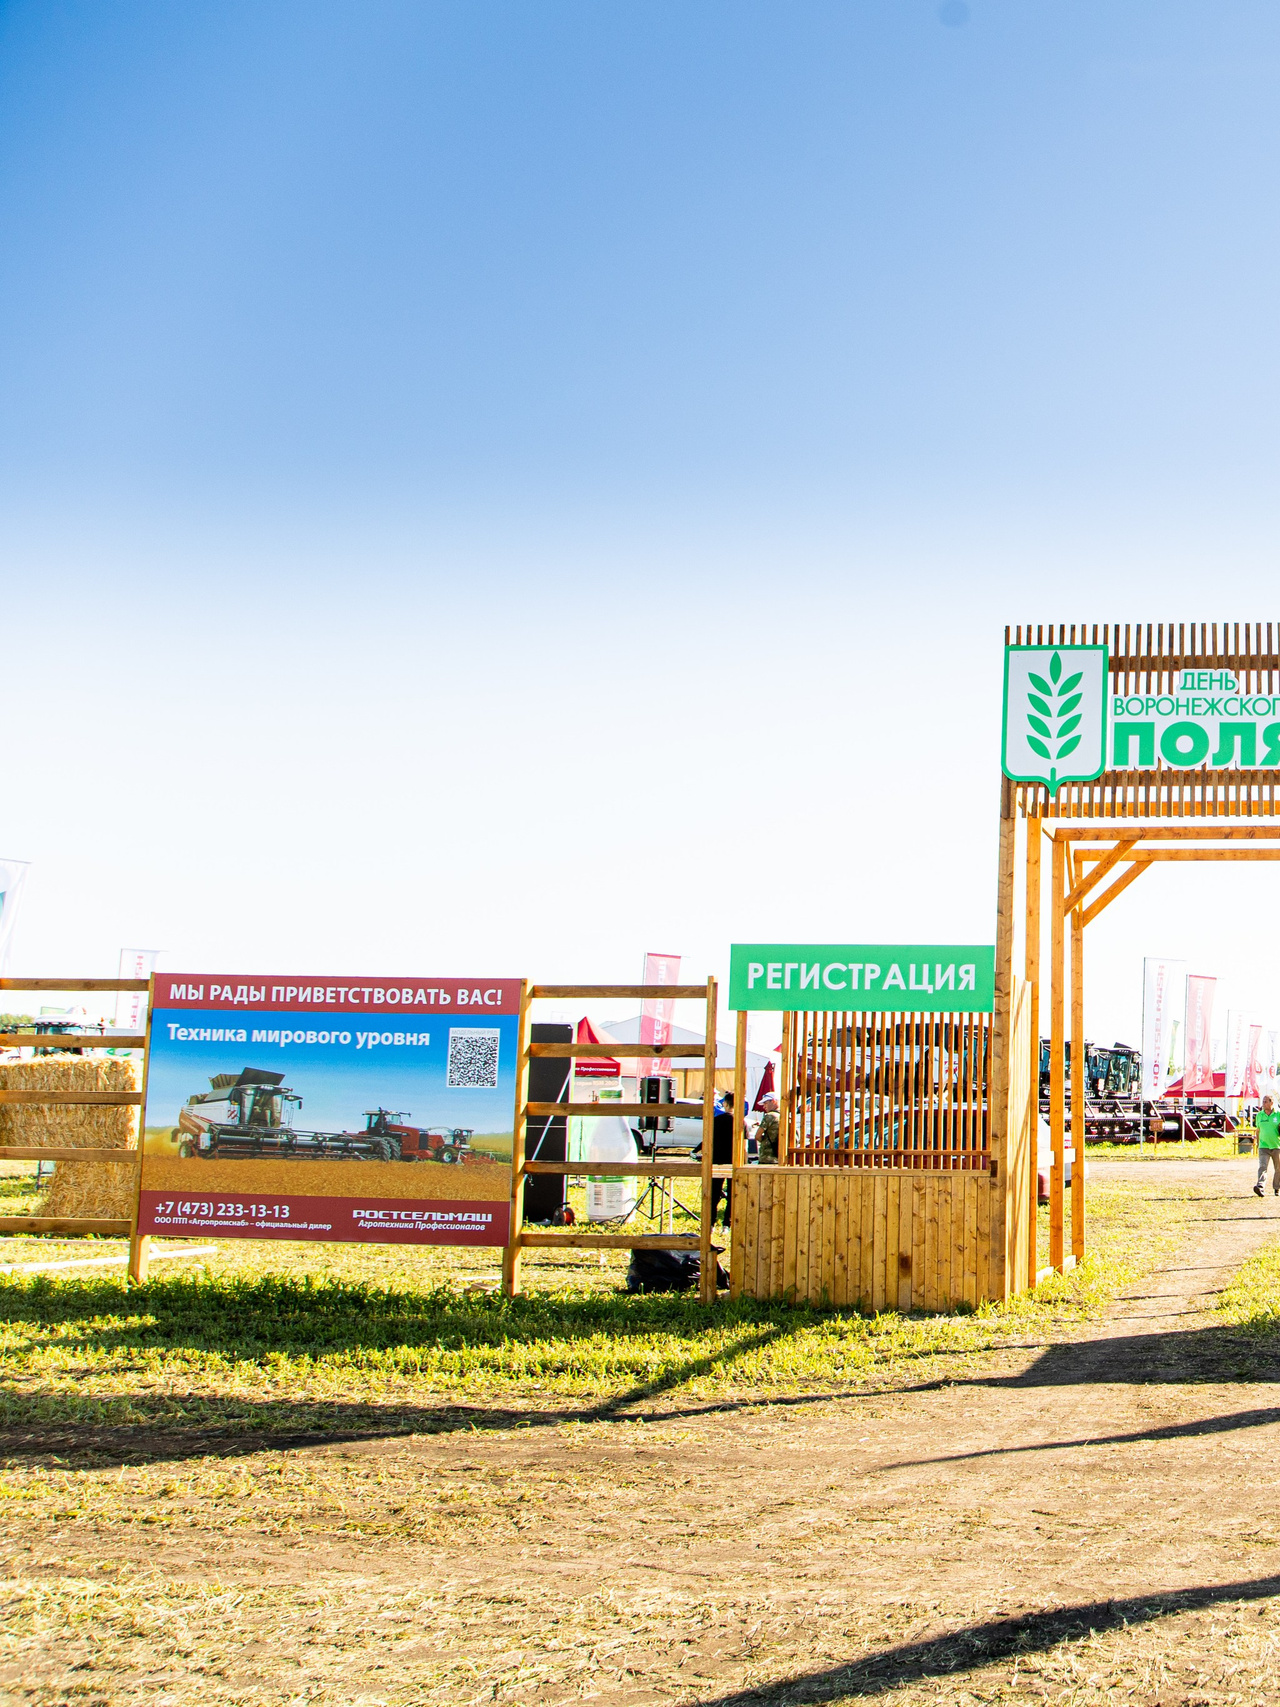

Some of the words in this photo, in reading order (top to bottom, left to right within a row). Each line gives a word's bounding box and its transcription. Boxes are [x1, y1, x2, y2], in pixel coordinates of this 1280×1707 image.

[1180, 672, 1236, 690] ДЕНЬ
[747, 962, 976, 994] РЕГИСТРАЦИЯ
[169, 983, 205, 1000] МЫ
[209, 984, 266, 1005] РАДЫ
[271, 985, 451, 1005] ПРИВЕТСТВОВАТЬ
[456, 988, 503, 1005] ВАС!
[167, 1023, 247, 1042] Техника
[251, 1029, 351, 1048] мирового
[356, 1031, 430, 1049] уровня
[155, 1201, 174, 1214] +7
[177, 1201, 214, 1217] (473)
[217, 1203, 290, 1219] 233-13-13
[352, 1209, 492, 1222] РОСТСЕЛЬМАШ
[255, 1220, 308, 1229] официальный
[308, 1223, 332, 1231] дилер
[358, 1219, 414, 1229] Агротехника
[415, 1221, 486, 1231] Профессионалов
